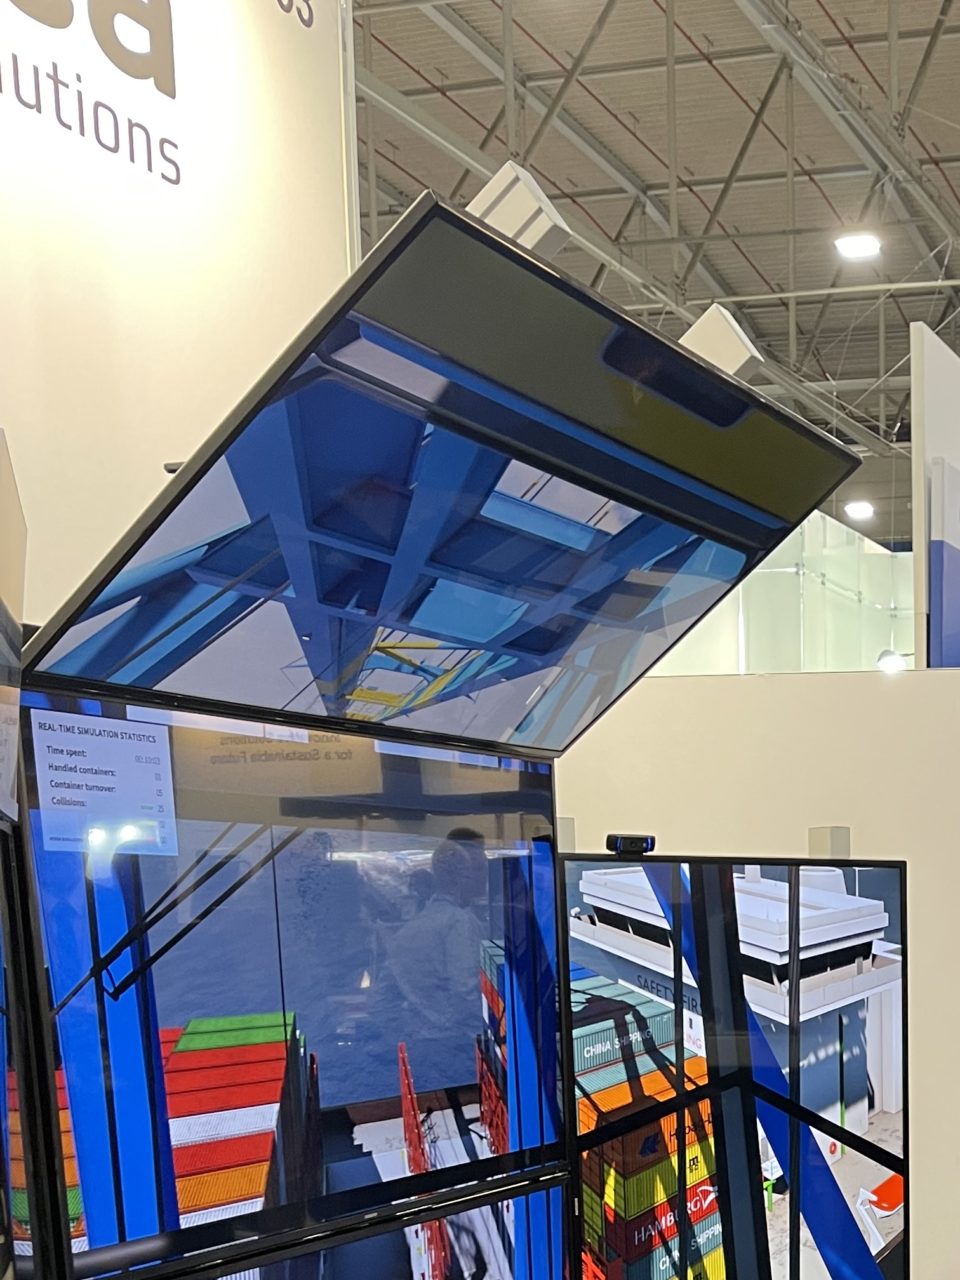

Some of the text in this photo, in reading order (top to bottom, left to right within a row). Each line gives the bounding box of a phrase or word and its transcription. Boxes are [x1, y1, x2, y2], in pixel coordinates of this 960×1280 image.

[0, 53, 181, 185] utions
[38, 722, 156, 744] REAL-TIME SIMULATION STATISTICS
[46, 745, 87, 758] Time spent:
[48, 763, 117, 777] Handled containers:
[50, 780, 116, 793] Container turnover:
[51, 797, 87, 807] Collisions:
[584, 1028, 652, 1058] CHINA SHIPPING
